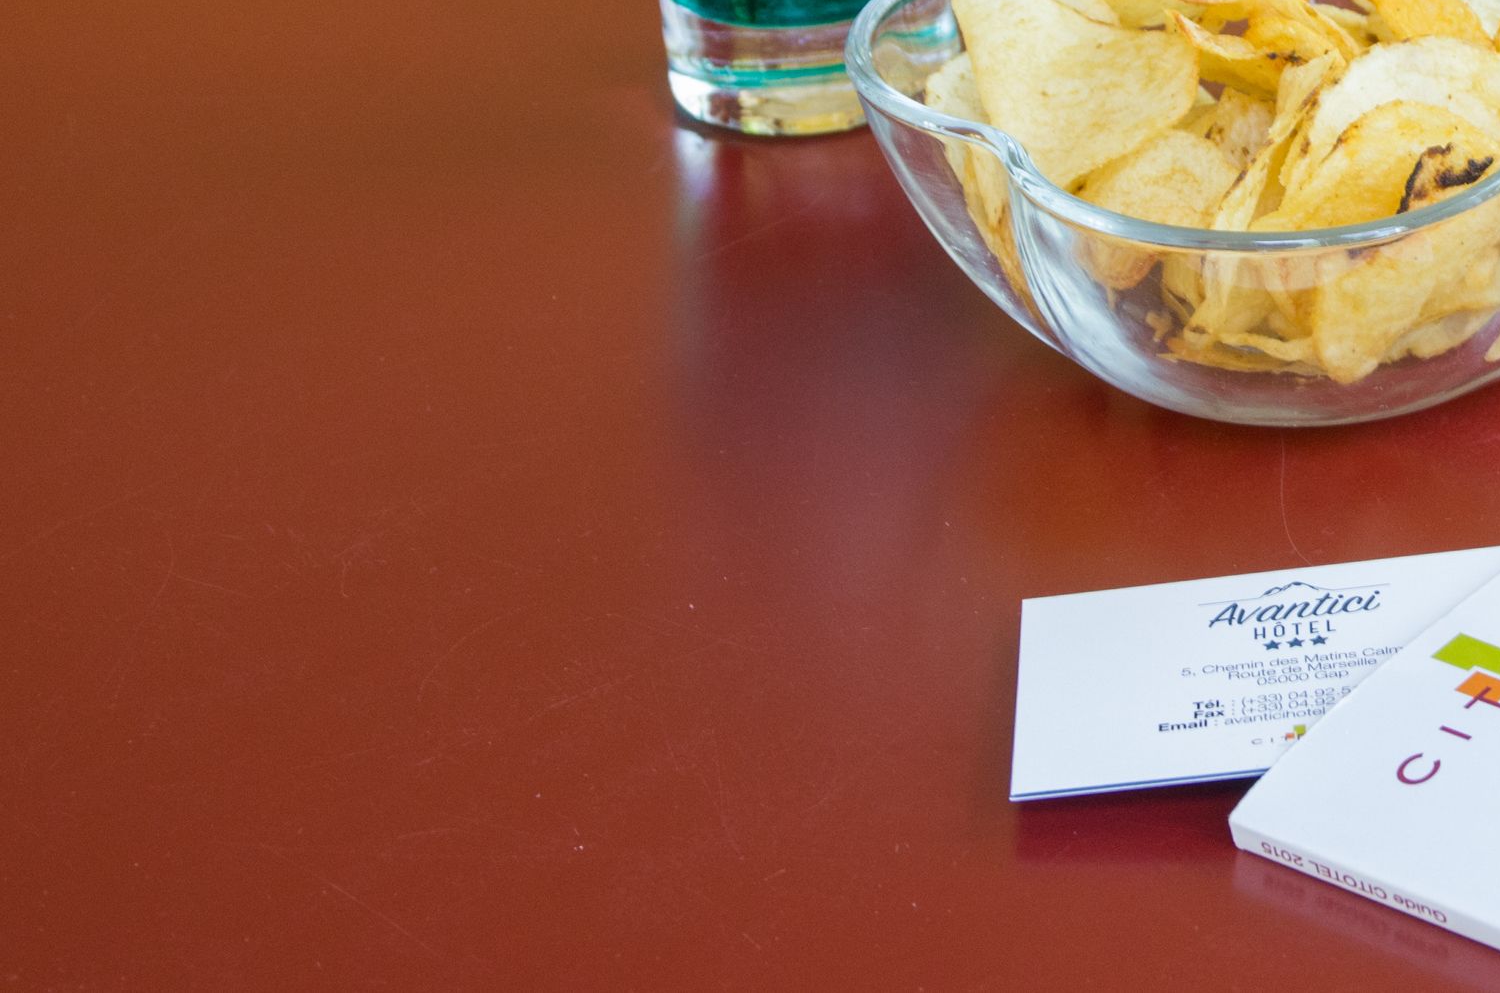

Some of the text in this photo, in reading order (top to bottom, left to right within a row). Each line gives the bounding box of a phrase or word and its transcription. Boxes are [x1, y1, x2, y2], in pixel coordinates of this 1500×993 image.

[1208, 590, 1381, 628] Avantici
[1254, 620, 1336, 640] HÔTEL
[1202, 659, 1264, 674] Chemin
[1274, 656, 1299, 667] des
[1304, 650, 1357, 663] Matins
[1228, 657, 1377, 680] Route de Marseille
[1256, 669, 1349, 686] 05000 Gap
[1241, 693, 1283, 707] (+33)
[1288, 685, 1353, 700] 04.92.5
[1193, 710, 1225, 719] Fax
[1241, 703, 1283, 716] (+33)
[1158, 719, 1208, 732] Email
[1261, 841, 1447, 923] Guide CITOTEL 2015
